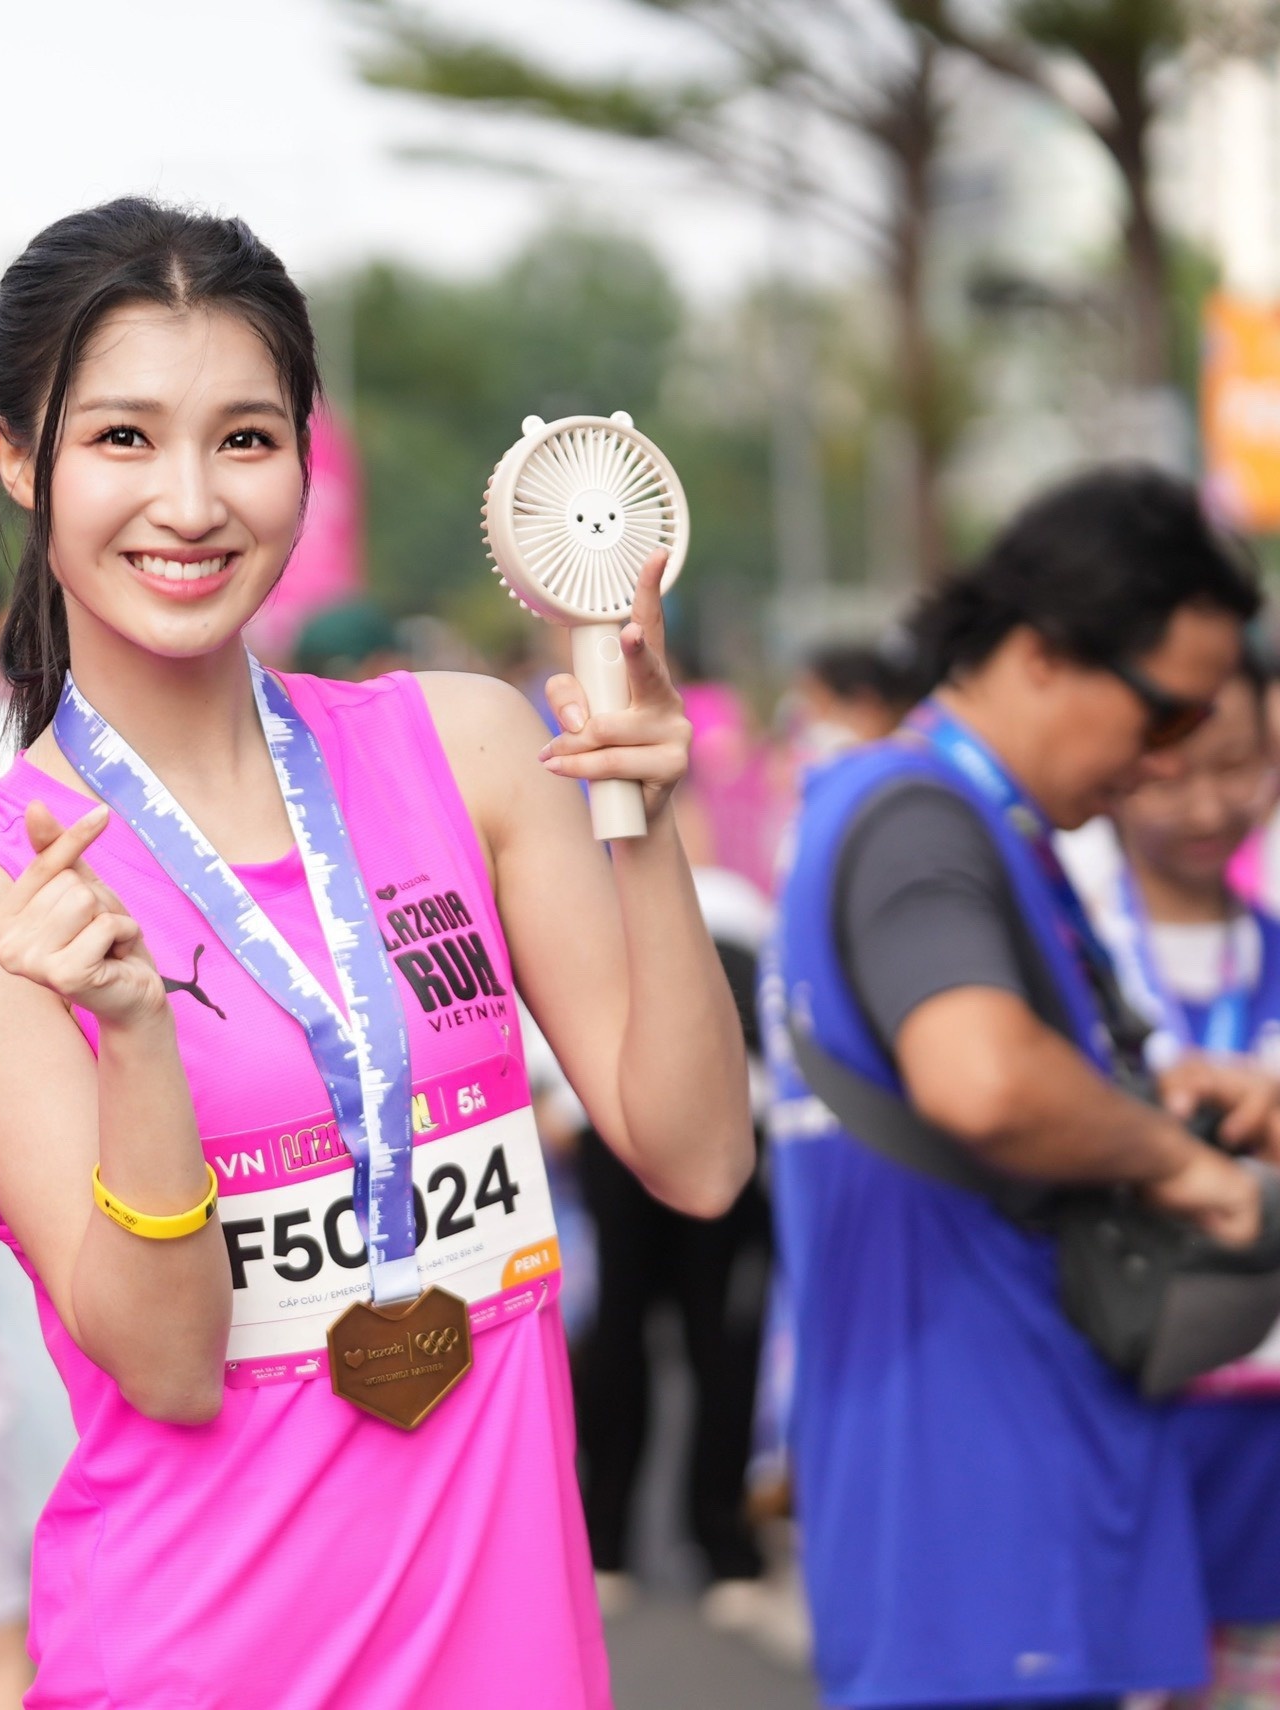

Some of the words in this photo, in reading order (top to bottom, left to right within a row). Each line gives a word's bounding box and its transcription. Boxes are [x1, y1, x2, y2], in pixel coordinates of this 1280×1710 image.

[393, 931, 507, 1013] RUN
[215, 1149, 266, 1179] VN
[280, 1120, 353, 1173] LAZA
[514, 1251, 540, 1275] PEN
